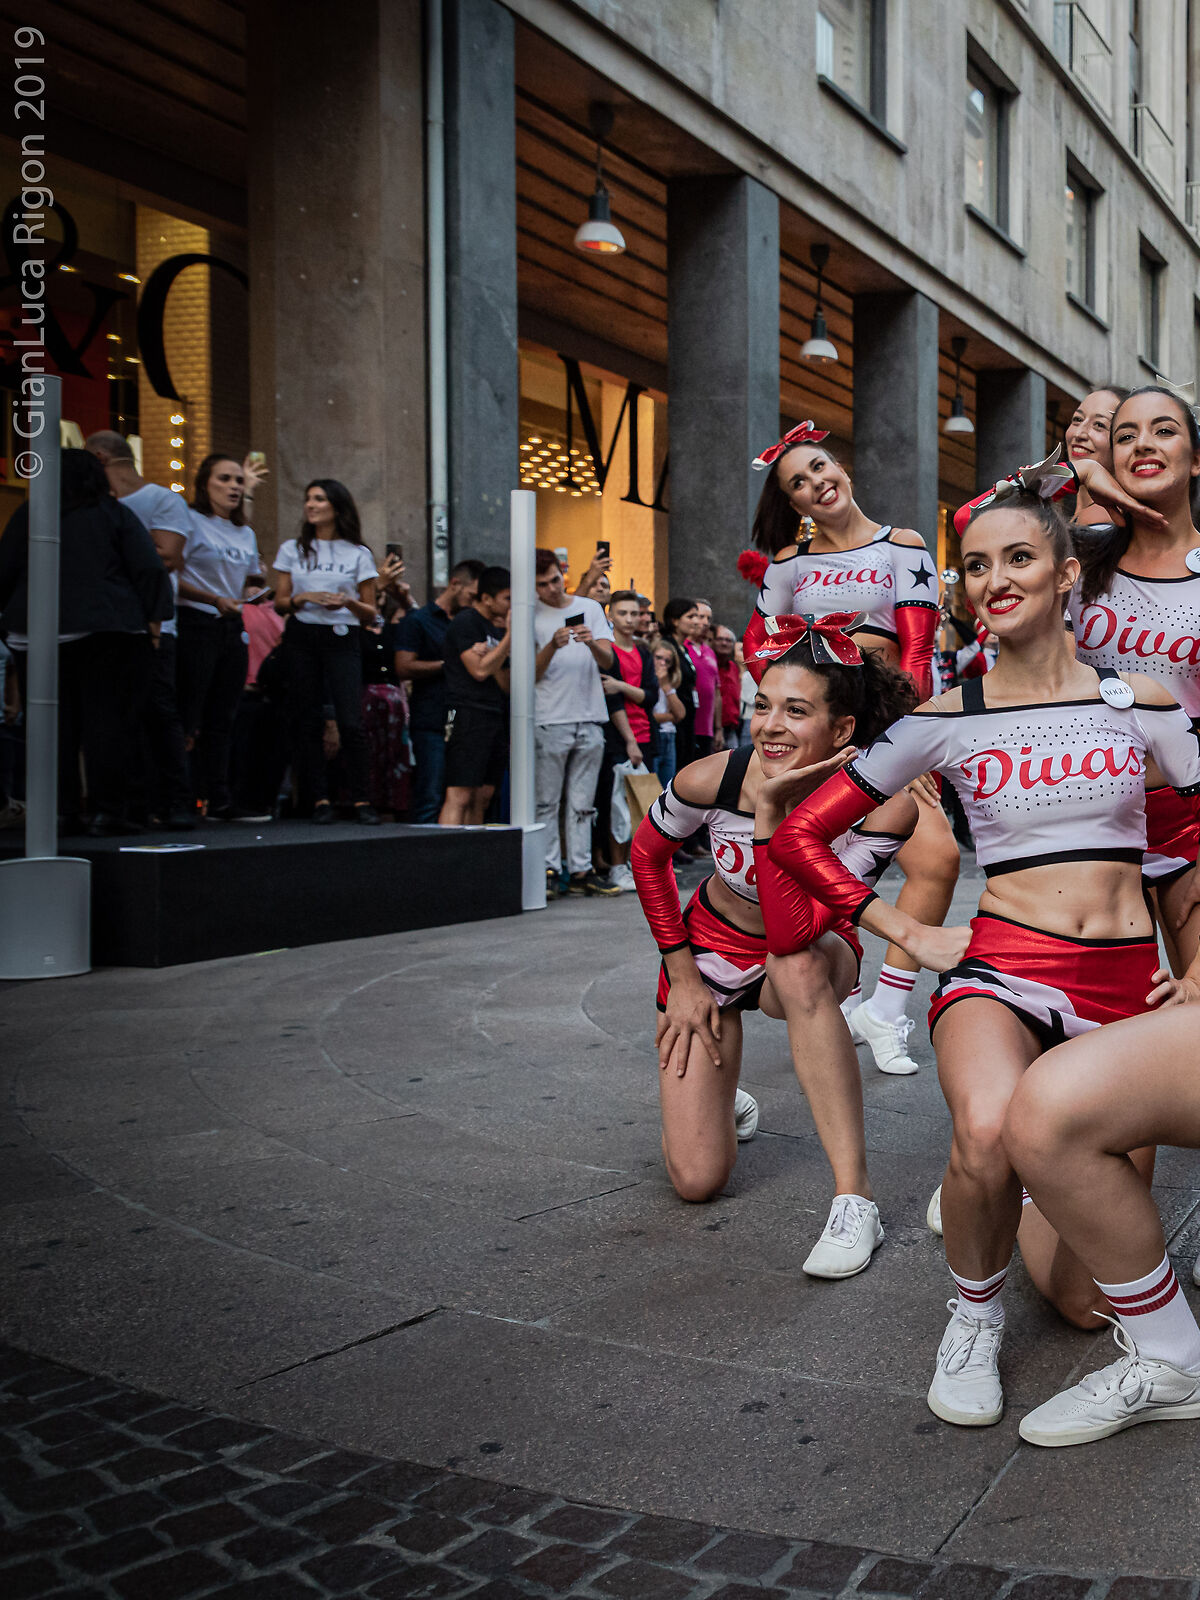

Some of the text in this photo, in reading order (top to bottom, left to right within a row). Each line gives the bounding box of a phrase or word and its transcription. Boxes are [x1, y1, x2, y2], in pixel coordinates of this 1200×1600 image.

[793, 568, 893, 597] Divas
[1104, 686, 1131, 697] VOGUE
[961, 746, 1141, 802] Divas
